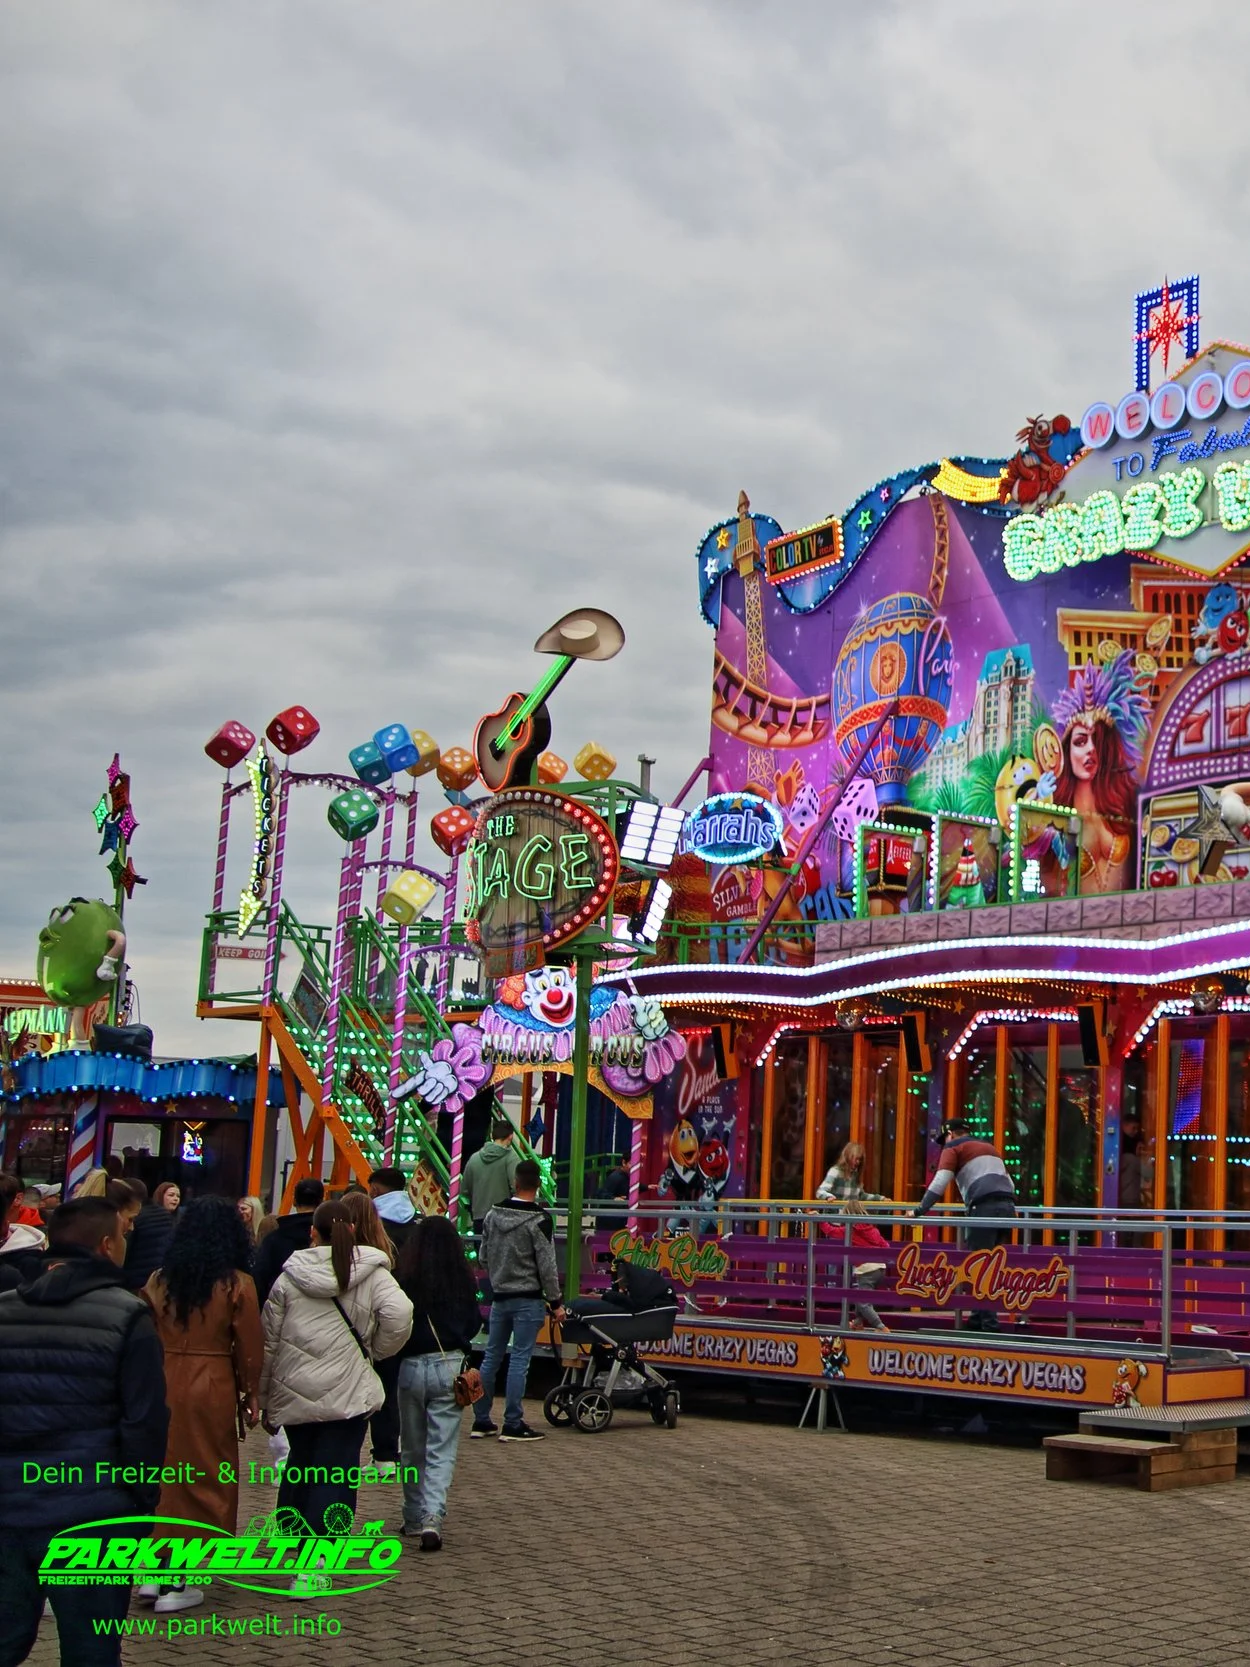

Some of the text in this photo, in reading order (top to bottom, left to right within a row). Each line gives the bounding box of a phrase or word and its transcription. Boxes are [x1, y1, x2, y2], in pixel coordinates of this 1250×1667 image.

[1112, 451, 1145, 481] TO
[1002, 467, 1207, 582] CRAZY
[769, 540, 802, 573] COLOR
[802, 533, 817, 561] TV
[252, 758, 271, 893] TICKETS
[486, 815, 515, 840] THE
[461, 833, 595, 923] STAGE
[218, 946, 243, 958] KEEP
[481, 1033, 554, 1065] CIRCUS
[668, 1235, 727, 1283] Roller
[898, 1245, 1069, 1307] Lucky Nugget
[695, 1335, 744, 1363] CRAZY
[746, 1340, 798, 1367] VEGAS
[867, 1347, 1086, 1392] WELCOME CRAZY VEGAS
